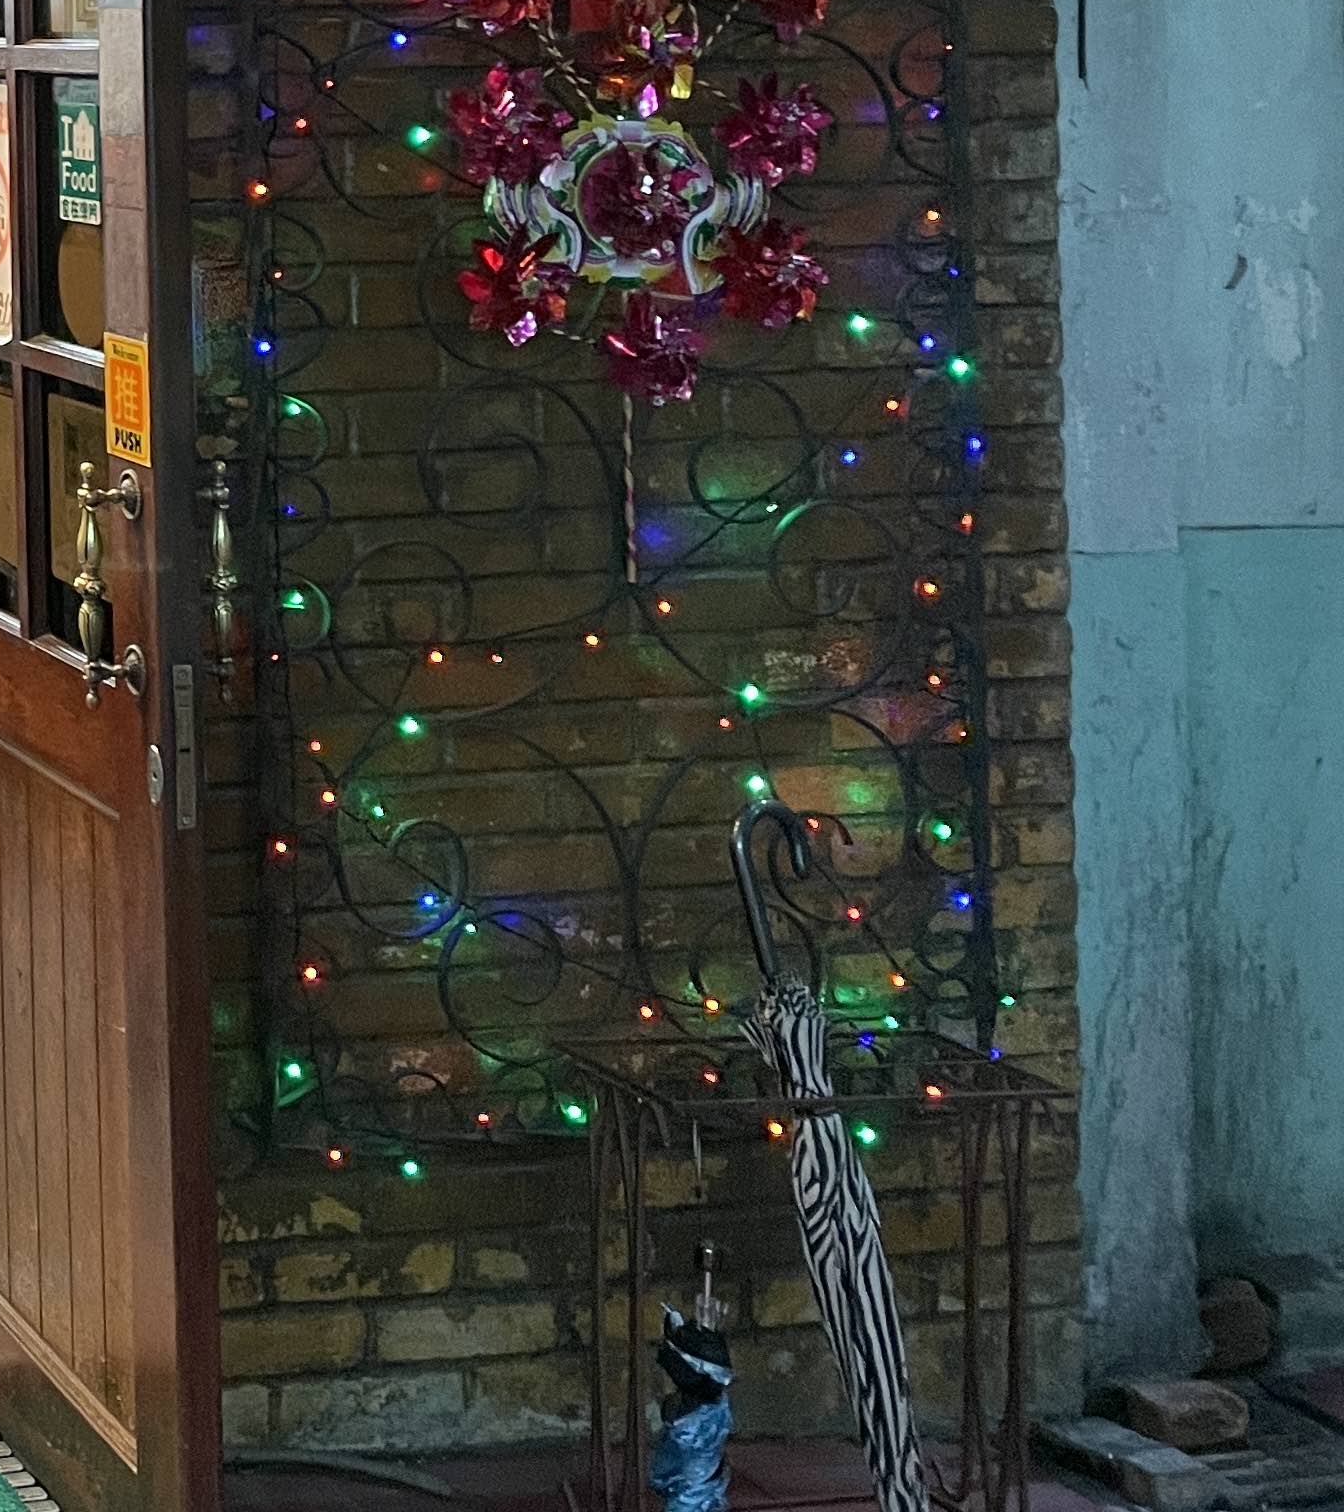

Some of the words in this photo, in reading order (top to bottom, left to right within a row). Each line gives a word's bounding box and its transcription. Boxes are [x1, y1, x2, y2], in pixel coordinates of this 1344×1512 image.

[62, 161, 97, 194] Food
[114, 364, 140, 425] 推
[114, 427, 142, 454] PUSH
